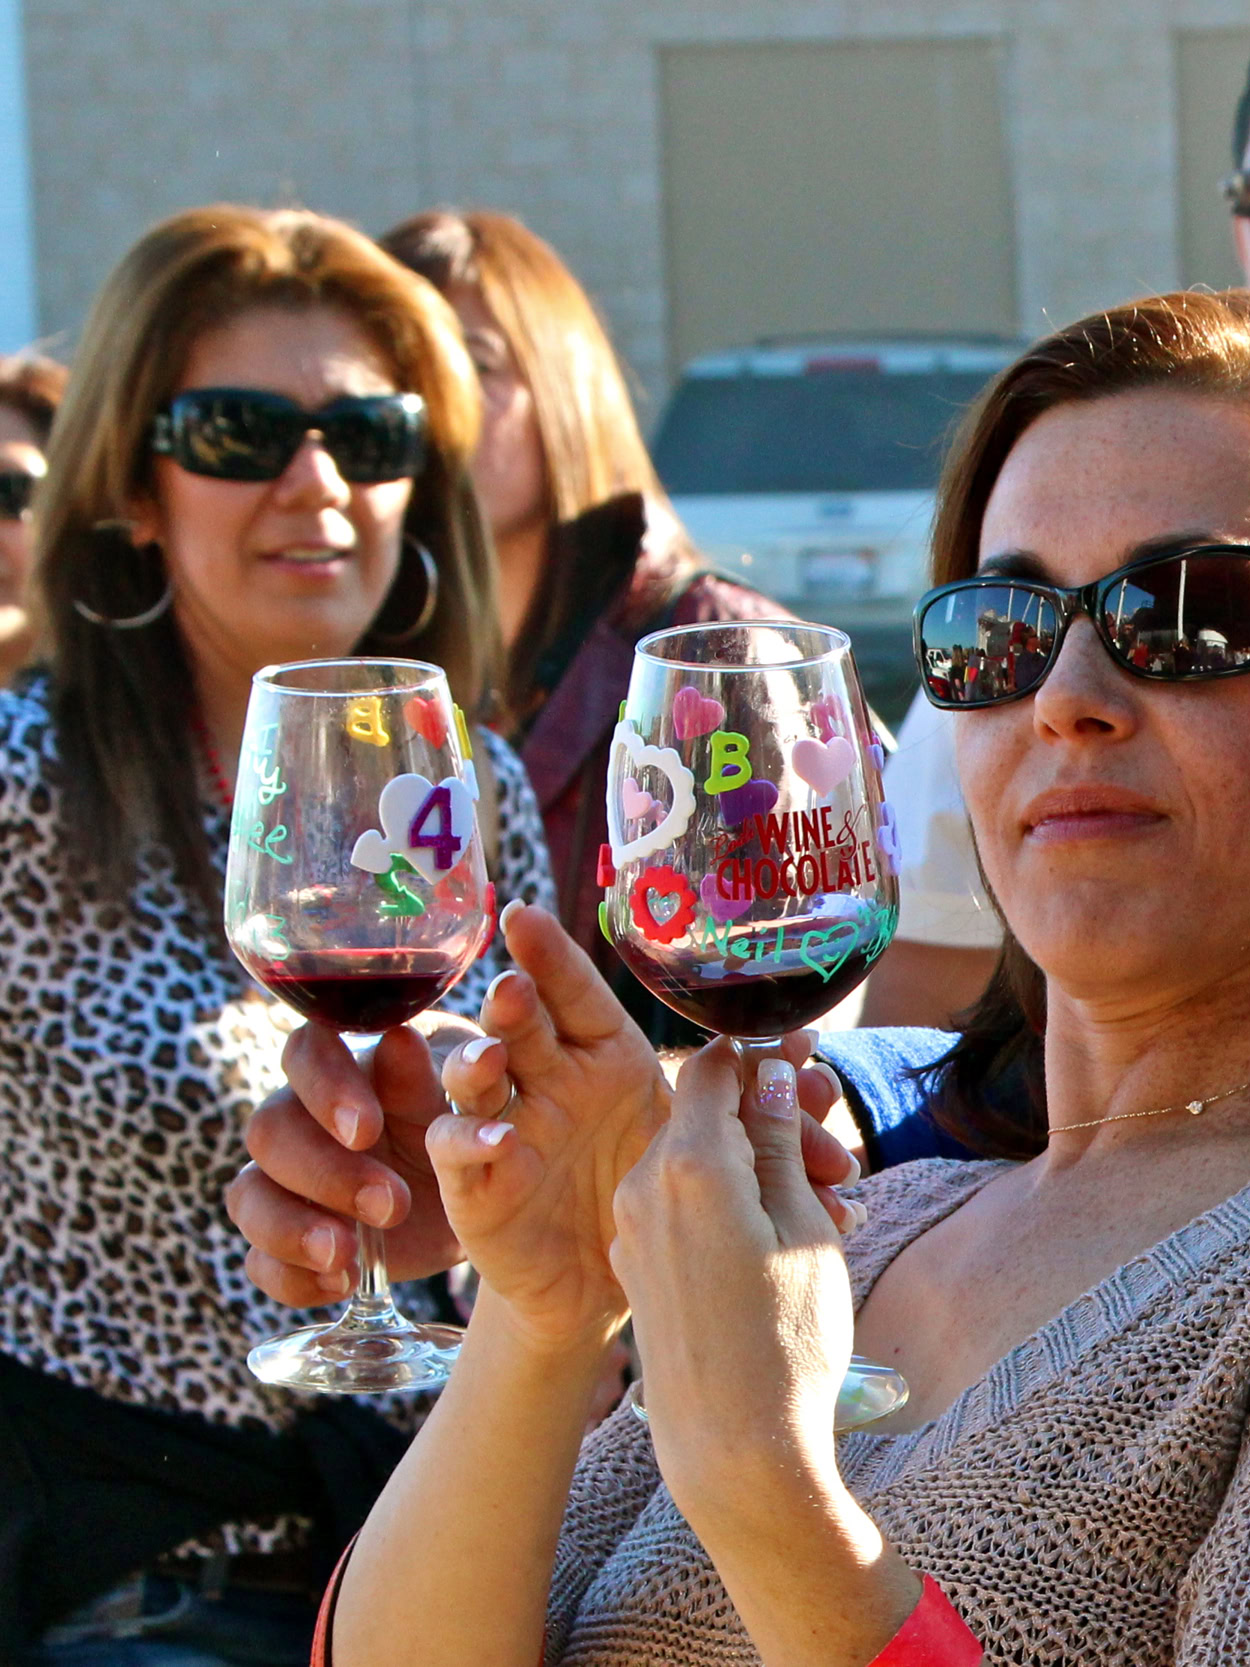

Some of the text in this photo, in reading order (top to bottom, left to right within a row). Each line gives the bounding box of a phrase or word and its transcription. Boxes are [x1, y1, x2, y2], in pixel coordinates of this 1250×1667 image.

[704, 730, 753, 795] B
[408, 786, 461, 870] 4
[753, 806, 836, 855] WINE
[837, 804, 868, 861] &
[717, 840, 876, 900] CHOCOLATE
[700, 916, 785, 963] Neil
